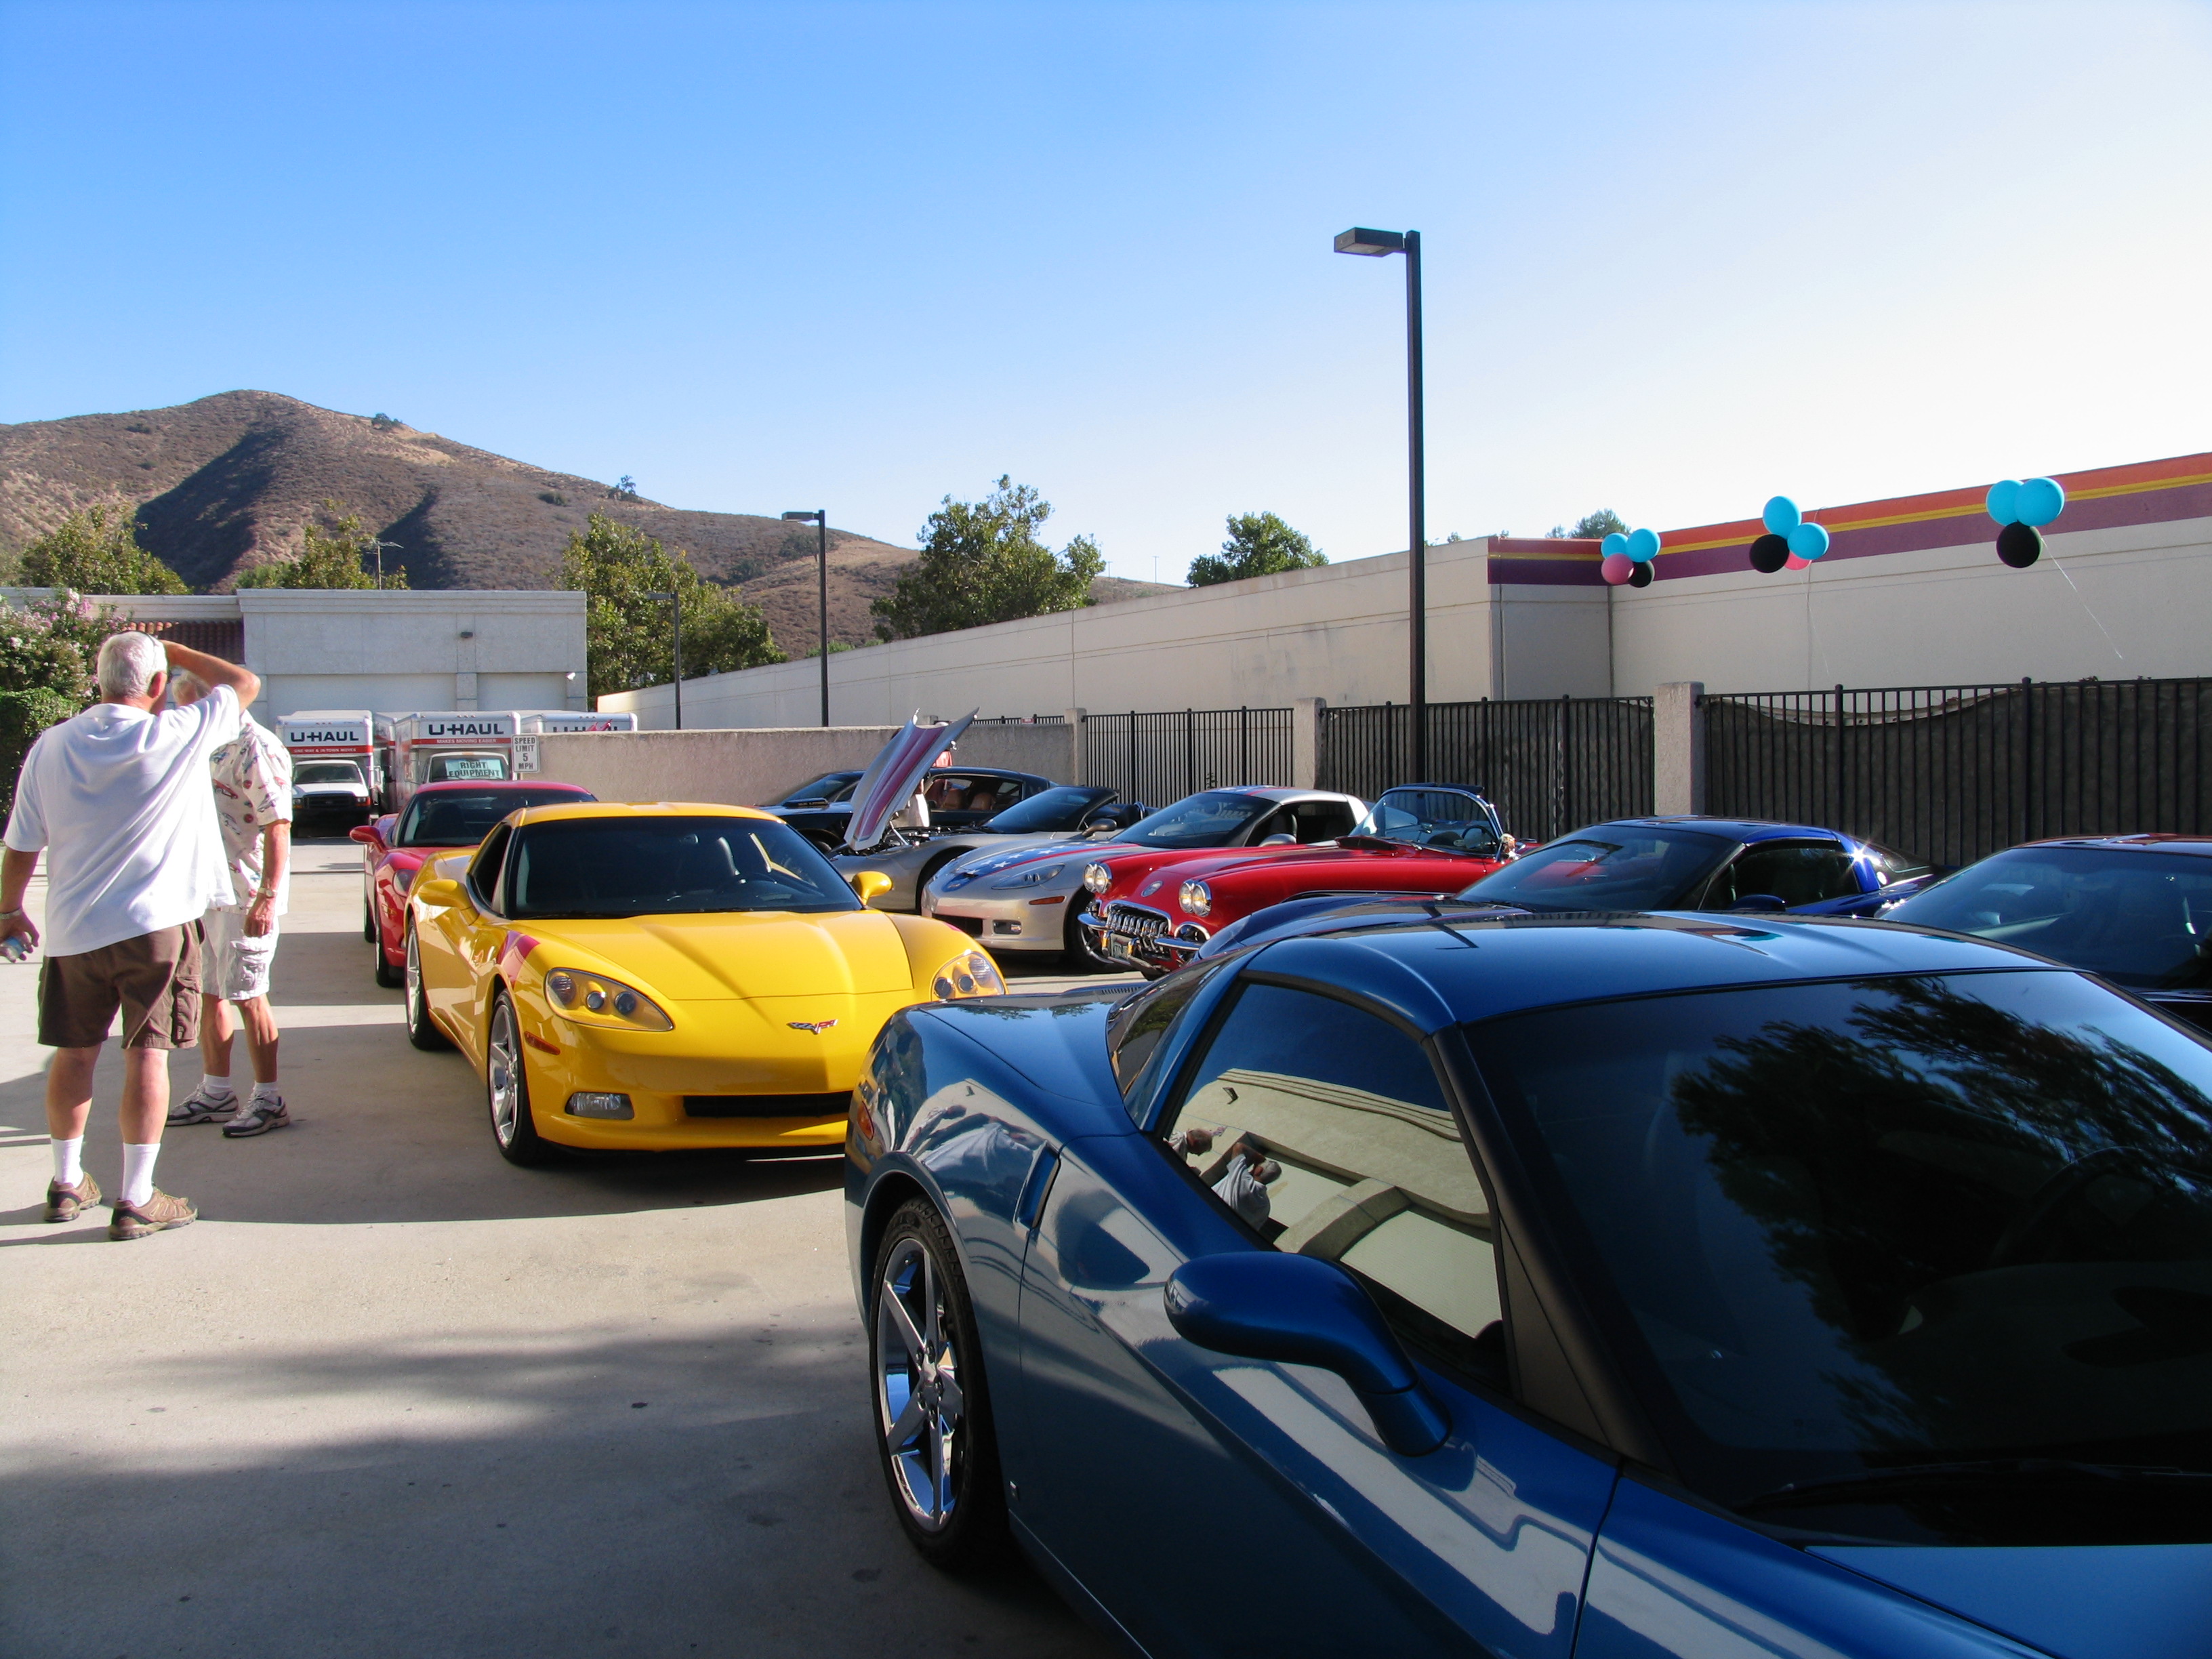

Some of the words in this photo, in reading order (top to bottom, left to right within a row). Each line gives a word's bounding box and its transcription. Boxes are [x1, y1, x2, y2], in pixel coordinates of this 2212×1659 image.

[428, 723, 504, 735] U-HAUL
[291, 731, 359, 742] U-HAUL
[523, 753, 528, 761] 5
